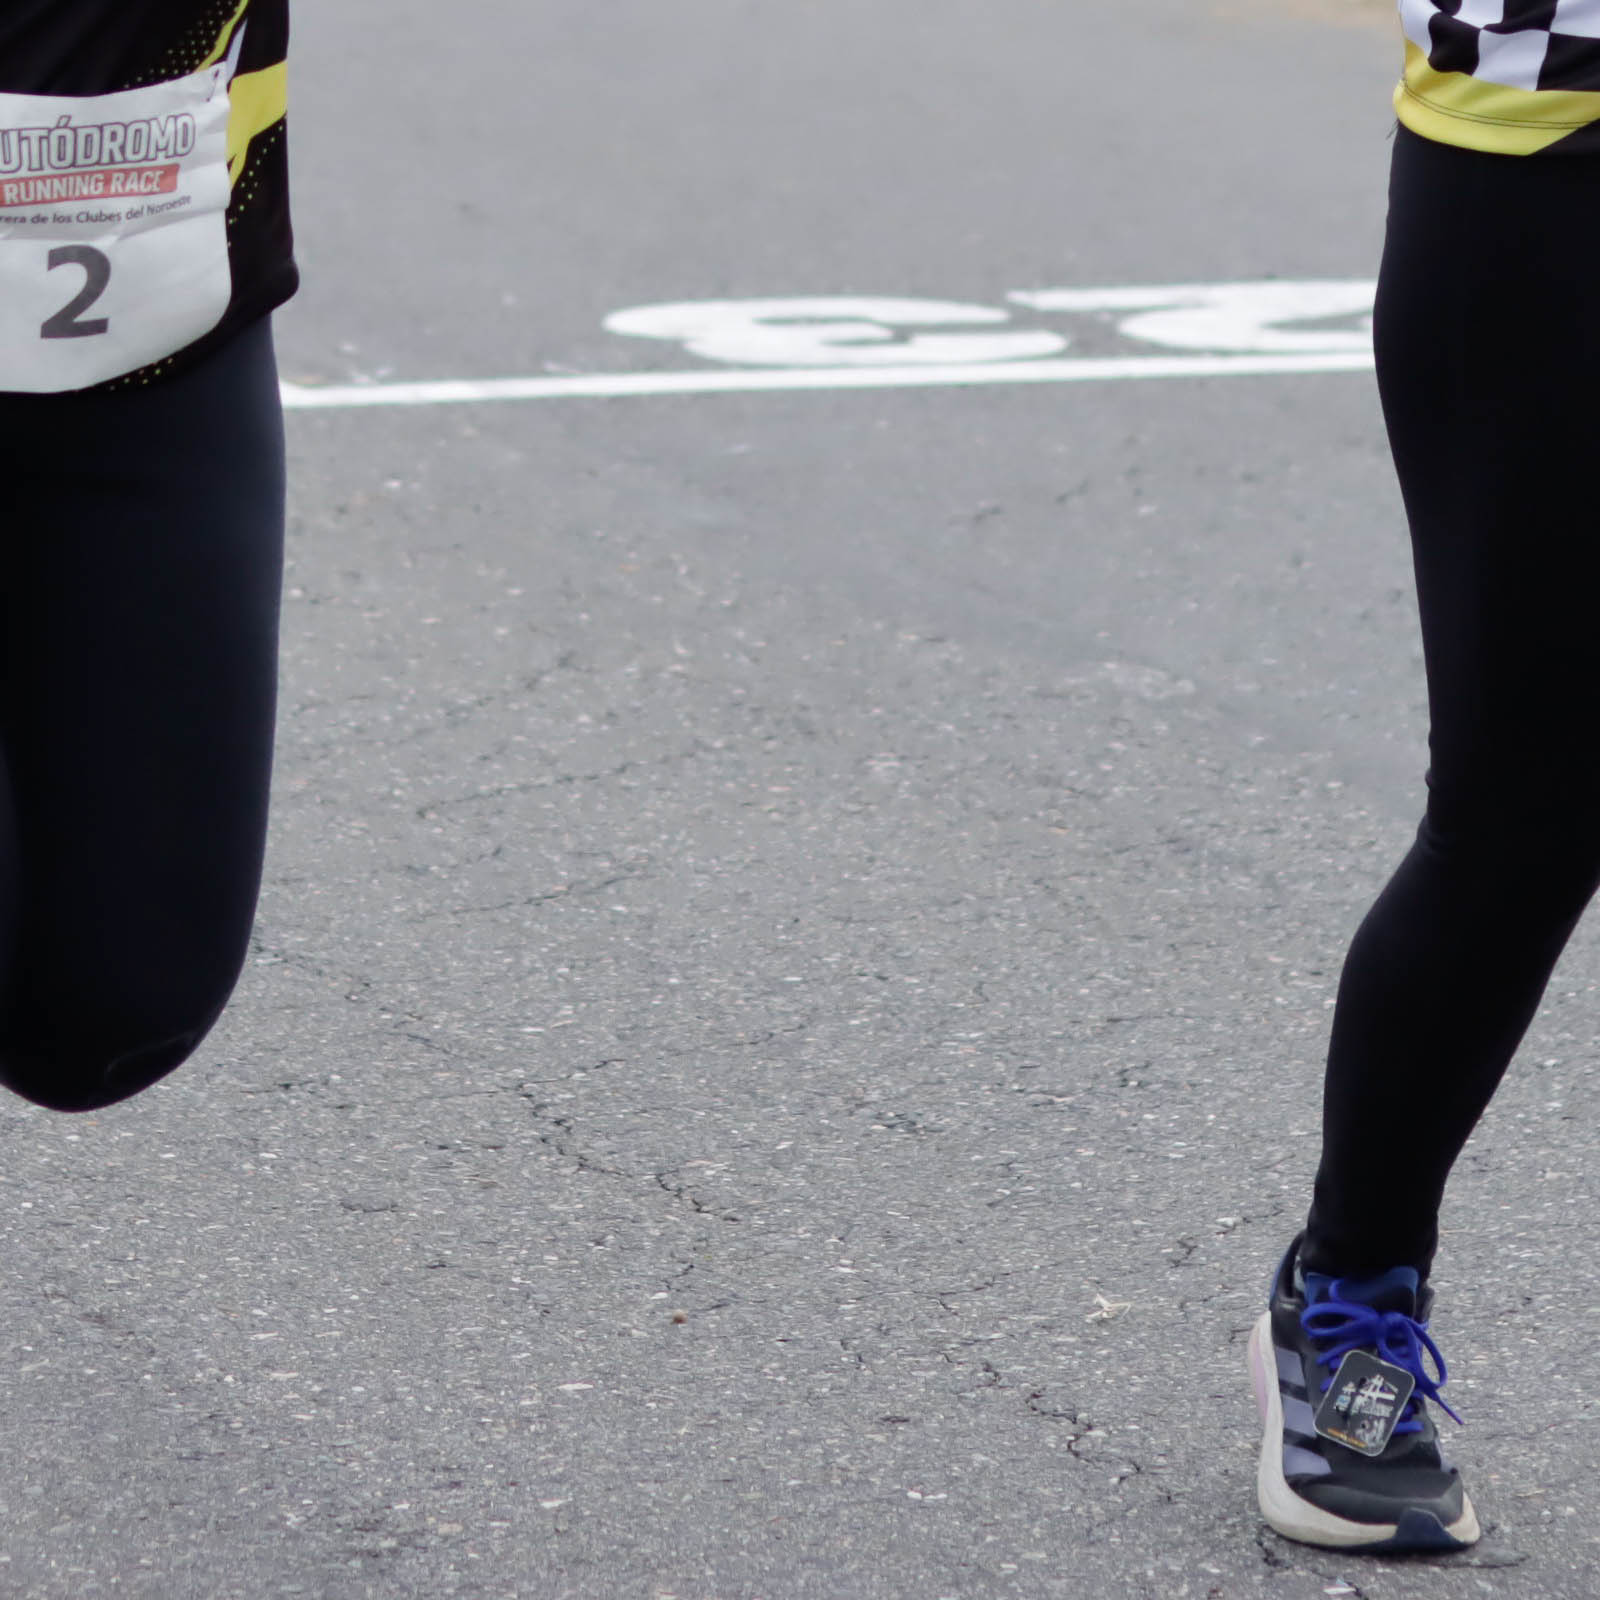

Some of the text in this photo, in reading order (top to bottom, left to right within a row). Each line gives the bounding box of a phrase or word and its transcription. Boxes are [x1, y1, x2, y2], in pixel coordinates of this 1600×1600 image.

[3, 170, 165, 205] RUNNING RACE
[31, 212, 49, 224] de
[53, 213, 72, 224] los
[76, 210, 122, 224] Clubes
[126, 207, 145, 220] del
[40, 244, 111, 339] 2
